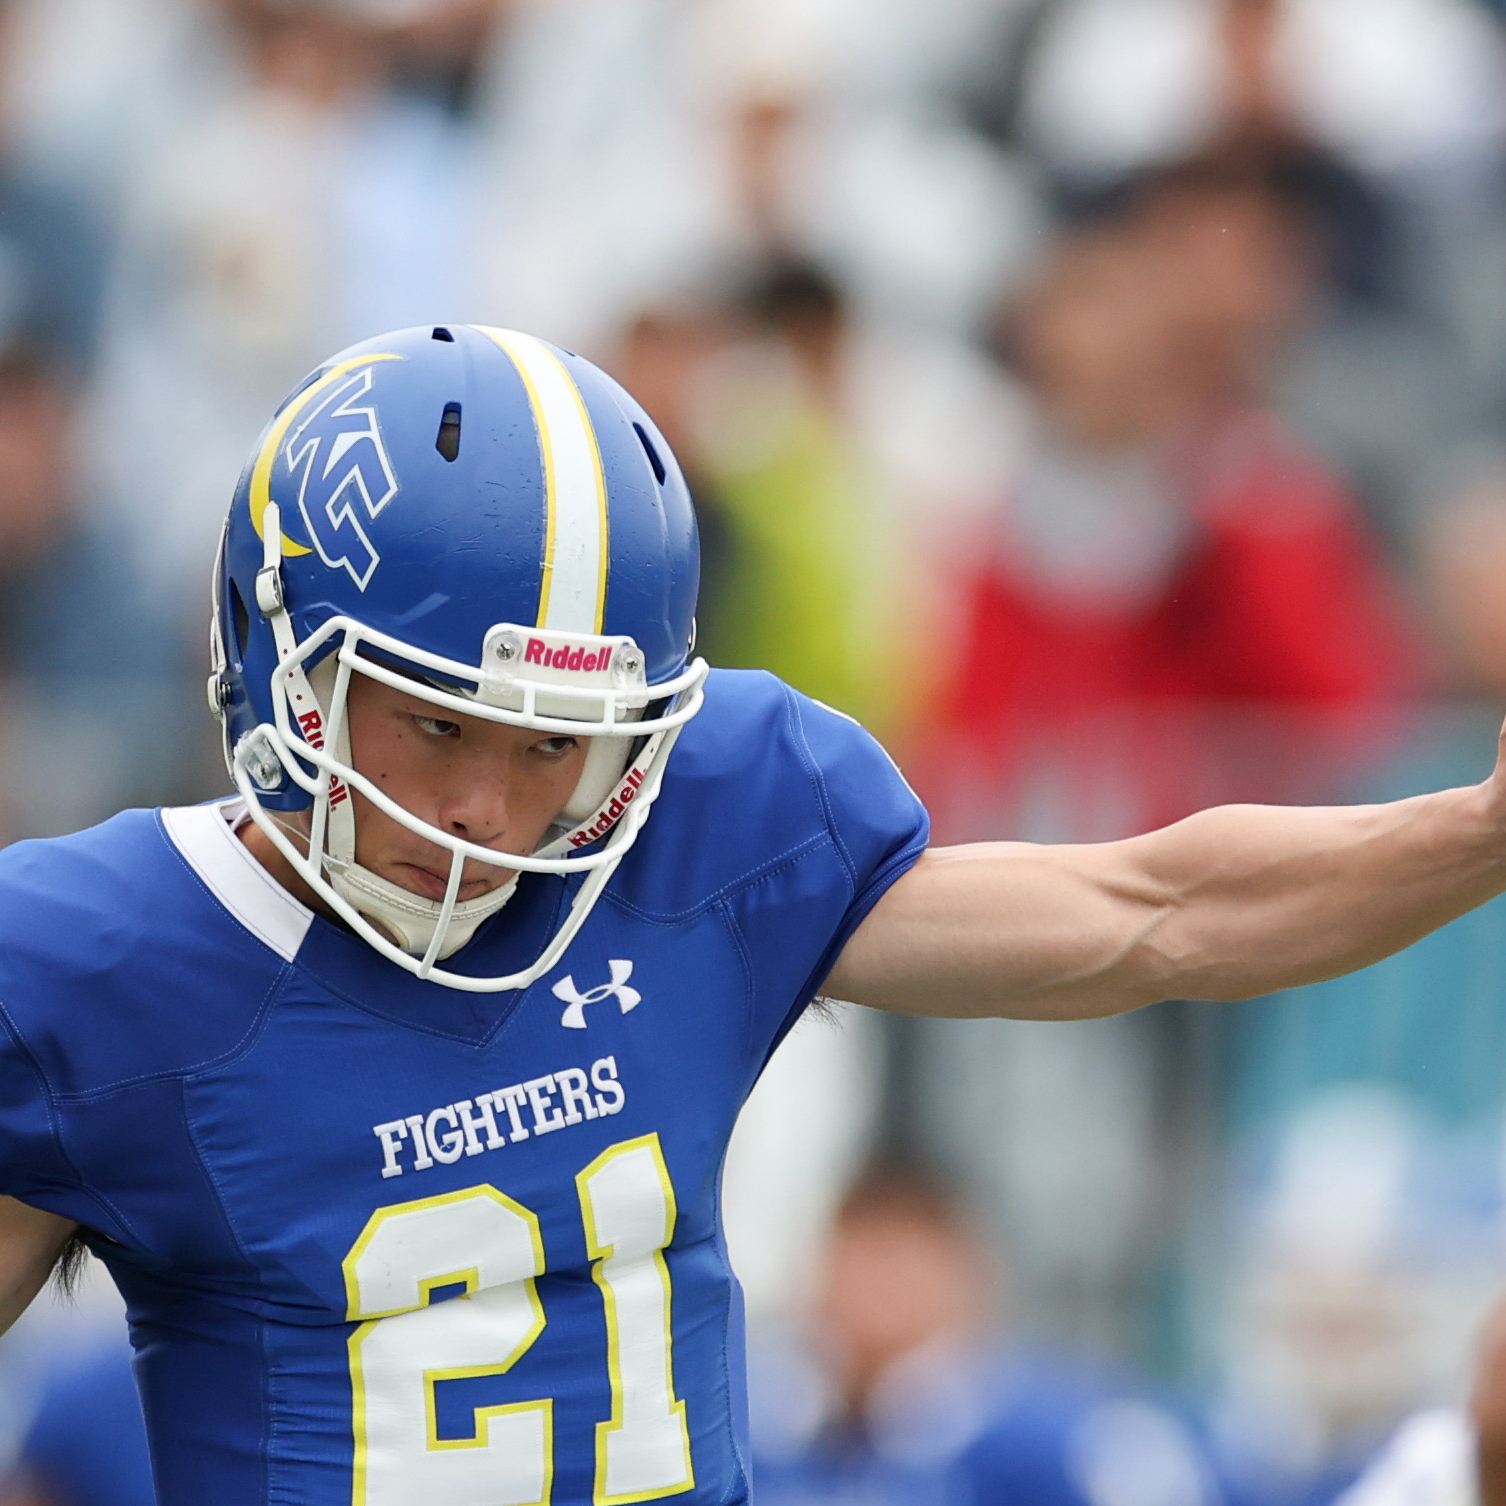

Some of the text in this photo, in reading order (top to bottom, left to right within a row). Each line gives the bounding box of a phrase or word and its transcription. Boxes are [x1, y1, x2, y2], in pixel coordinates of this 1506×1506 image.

[524, 637, 613, 672] Riddell
[566, 767, 646, 848] Riddell
[373, 1055, 626, 1179] FIGHTERS
